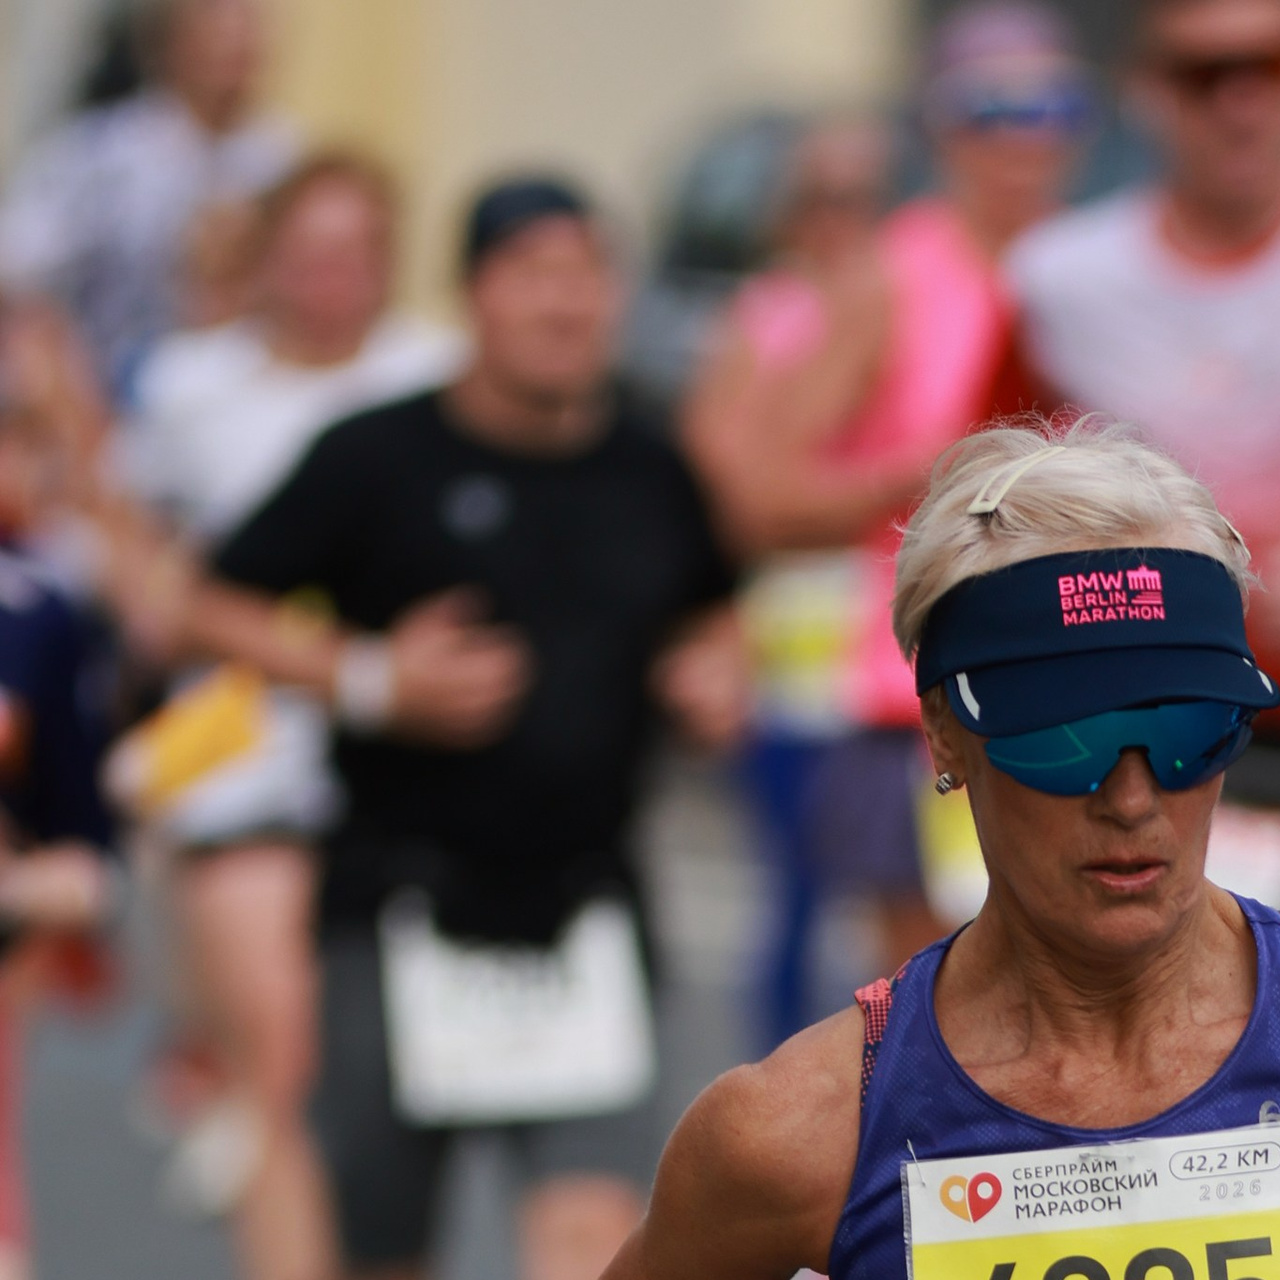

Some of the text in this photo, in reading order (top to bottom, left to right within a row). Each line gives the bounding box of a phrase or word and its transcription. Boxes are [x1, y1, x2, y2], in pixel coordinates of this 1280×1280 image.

[1058, 570, 1123, 596] BMW
[1061, 591, 1127, 611] BERLIN
[1063, 606, 1165, 626] MARATHON
[1012, 1158, 1118, 1180] СБЕРПРАЙМ
[1183, 1153, 1227, 1173] 42,2
[1013, 1169, 1158, 1200] МОСКОВСКИЙ
[1015, 1195, 1122, 1219] МАРАФОН
